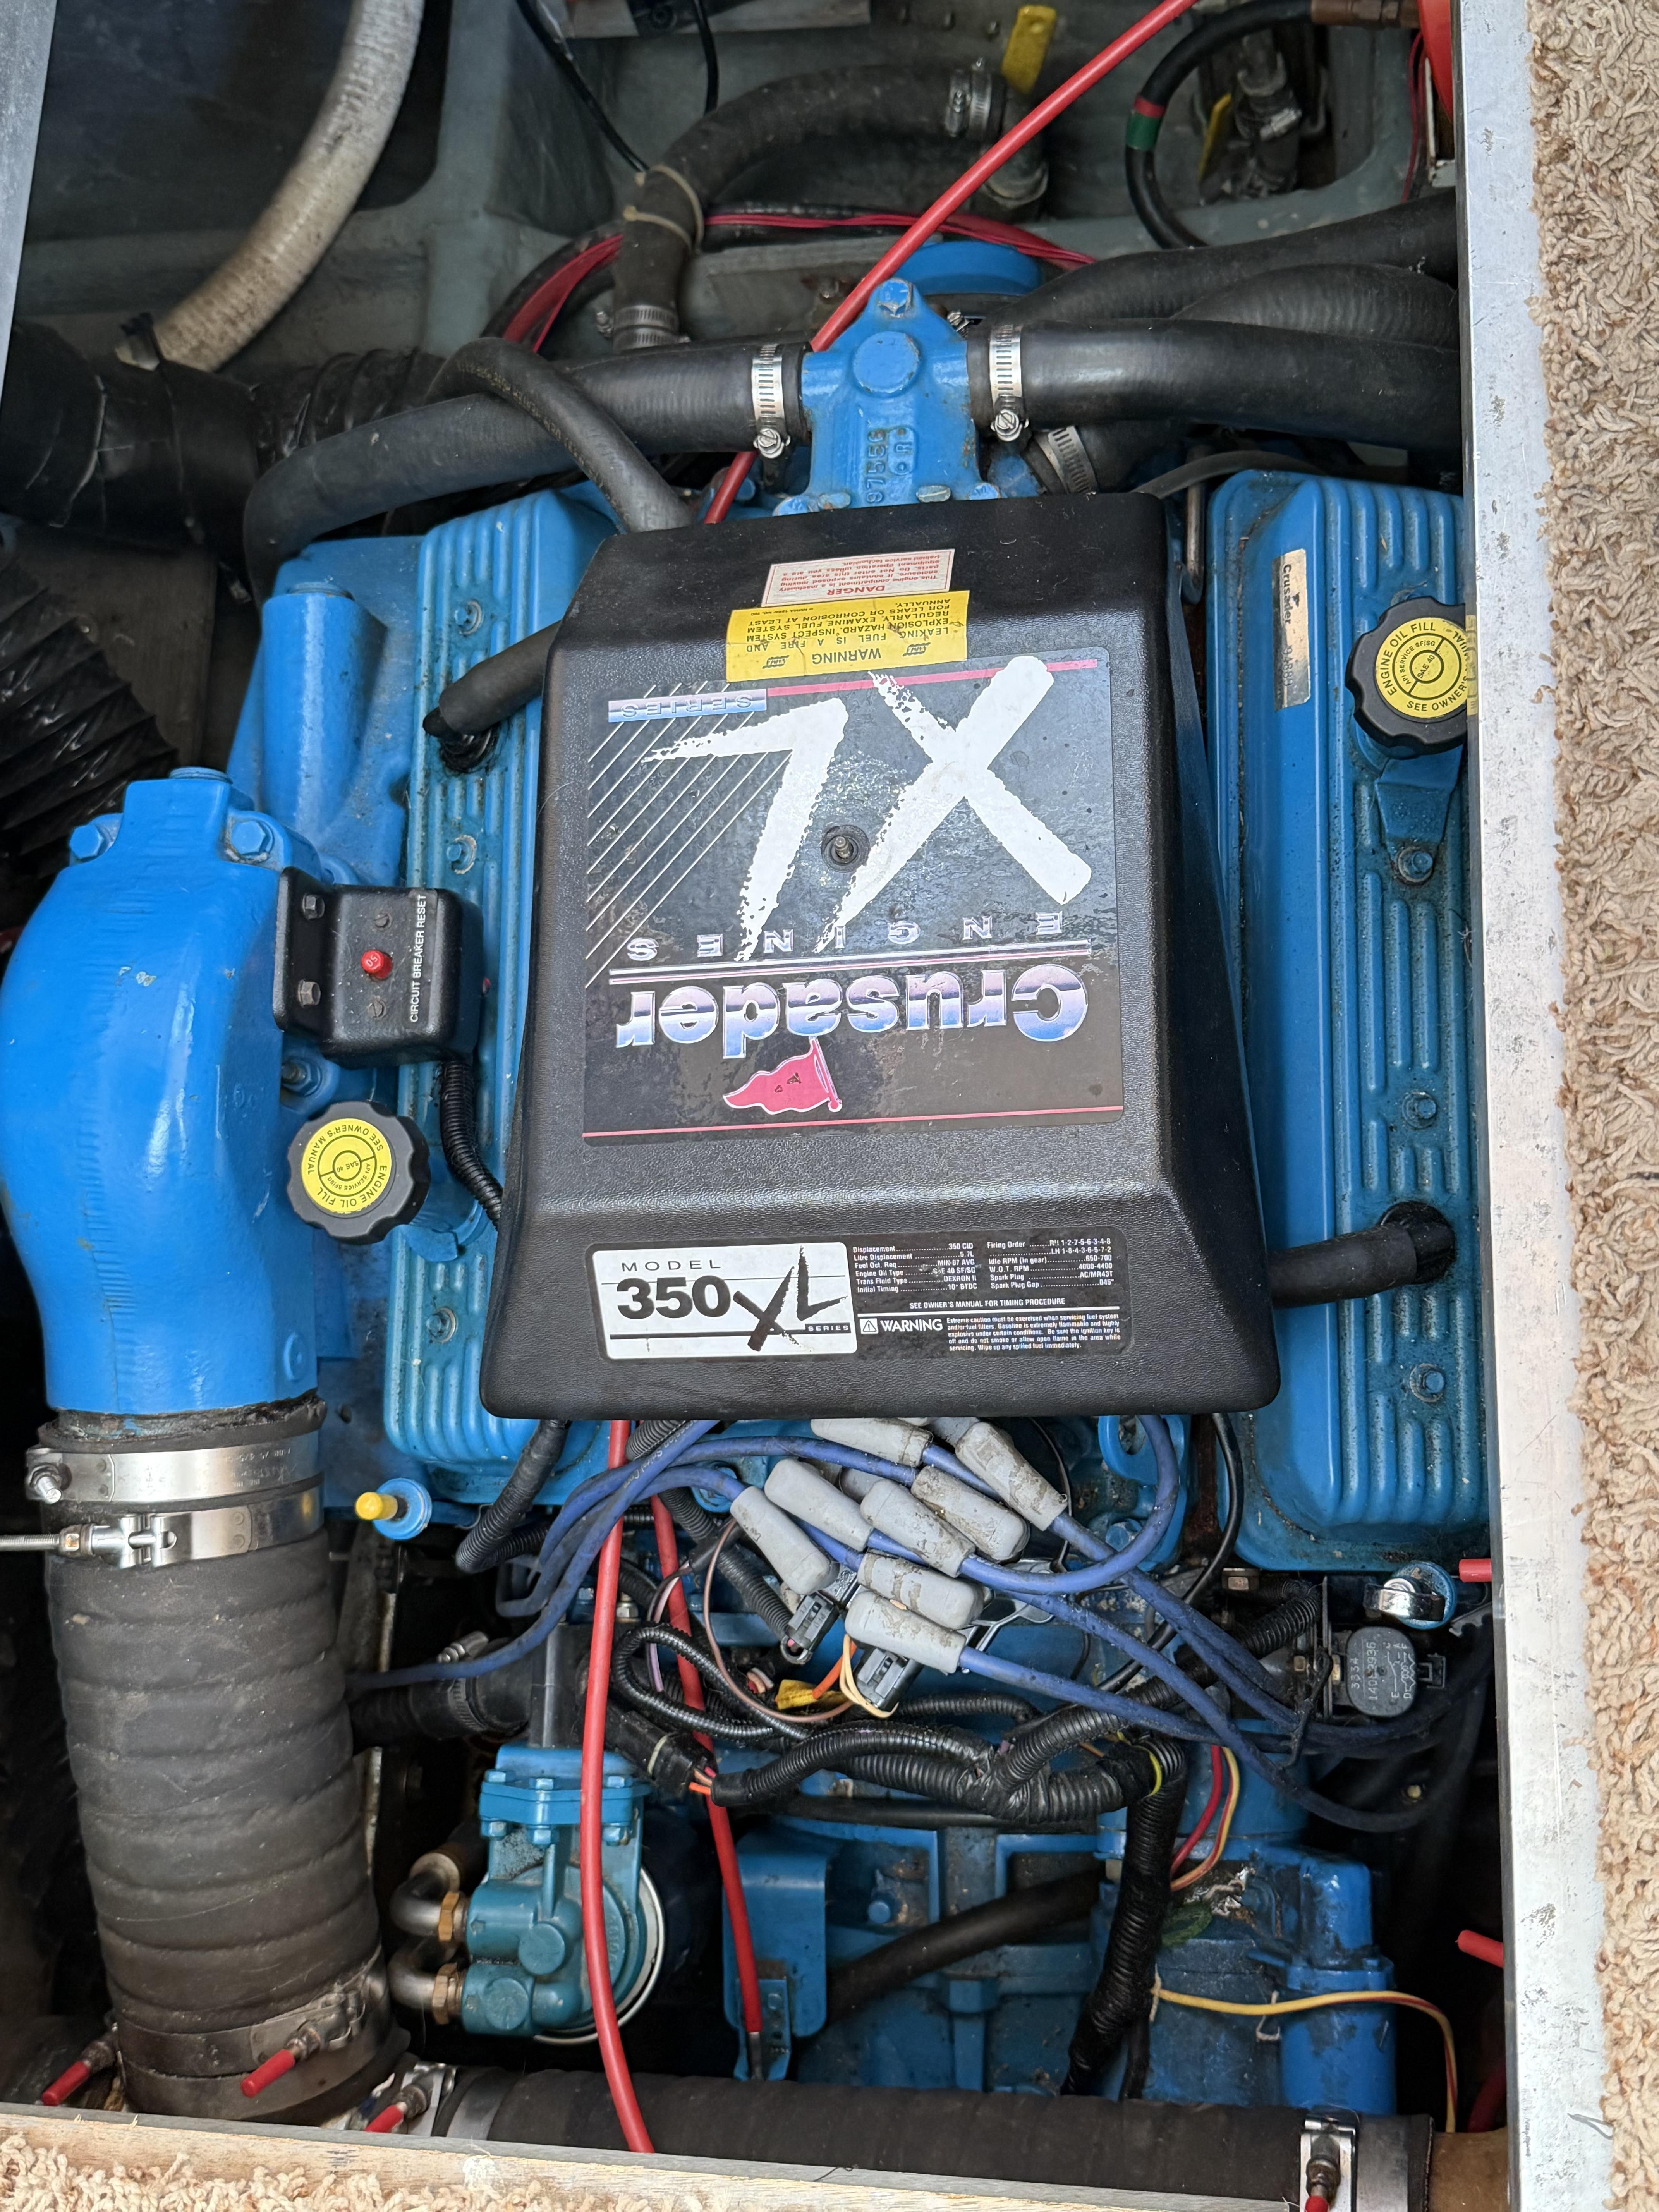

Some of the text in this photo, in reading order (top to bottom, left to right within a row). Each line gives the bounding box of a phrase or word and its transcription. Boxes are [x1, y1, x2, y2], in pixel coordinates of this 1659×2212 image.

[826, 585, 885, 595] DANGER
[1281, 564, 1293, 625] Crusader
[895, 599, 950, 608] ANNUALLY.
[802, 611, 865, 621] CORROSION
[828, 617, 875, 626] EXAMINE
[881, 610, 948, 621] REGULARLY.
[746, 618, 948, 642] EXPLOSION HAZARD. INSPECT SYSTEM
[747, 624, 790, 633] SYSTEM
[899, 627, 948, 638] LEAKING
[780, 640, 805, 649] FIRE
[857, 633, 886, 642] FUEL
[746, 644, 768, 652] AND
[811, 648, 881, 665] WARNING
[1381, 622, 1436, 696] ENGINE OIL FILL
[1400, 646, 1414, 673] SERVICE
[1417, 655, 1435, 678] SAE 40
[1402, 675, 1411, 685] API
[620, 694, 754, 718] SERIES
[1407, 701, 1427, 711] SEE
[641, 656, 1091, 961] XL
[625, 911, 1063, 962] ENGINES
[410, 895, 427, 1022] CIRCUIT BREAKER RESET
[615, 964, 1089, 1058] Crusader
[307, 1125, 383, 1175] SEE OWNER'S MANUAL
[345, 1161, 359, 1169] SAE
[316, 1166, 386, 1208] ENGINE OIL FILL
[344, 1176, 366, 1190] SERVICE
[622, 1260, 721, 1271] MODEL
[1030, 1256, 1047, 1264] gear)
[617, 1246, 848, 1351] 350 XL
[880, 1318, 943, 1332] WARNING
[1350, 1657, 1360, 1689] 3334
